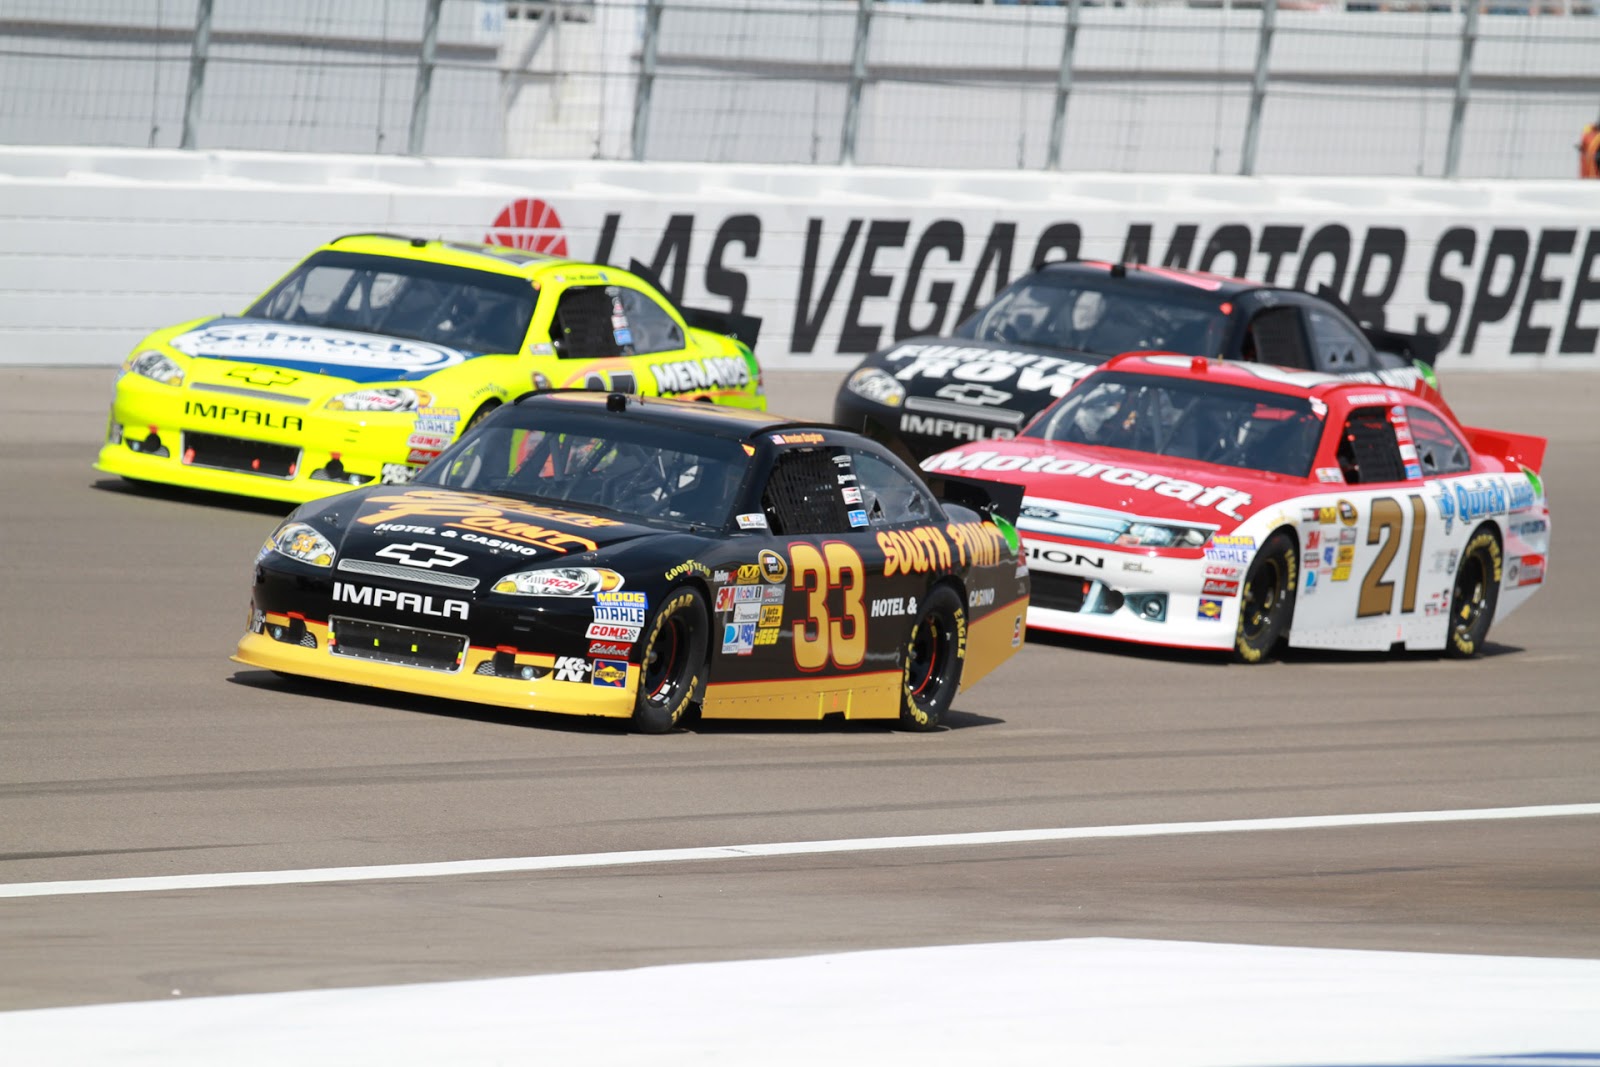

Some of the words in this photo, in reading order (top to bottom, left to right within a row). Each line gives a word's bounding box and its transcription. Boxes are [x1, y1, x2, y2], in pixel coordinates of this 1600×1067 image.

[650, 356, 751, 394] MENARDS
[184, 401, 304, 431] IMPALA
[415, 420, 455, 434] MAHLE
[410, 434, 441, 448] COMP
[930, 450, 1253, 516] Motorcraft
[374, 523, 436, 536] HOTEL
[440, 530, 458, 538] &
[461, 533, 537, 556] CASINO
[876, 526, 951, 577] SOUTH
[946, 520, 1004, 568] POINT
[1206, 549, 1248, 563] MAHLE
[1356, 494, 1427, 618] 21
[663, 559, 712, 582] GOODYEAR
[332, 581, 470, 621] IMPALA
[596, 592, 645, 603] MOOG
[716, 587, 737, 611] 3M
[737, 586, 755, 599] Mobil
[871, 600, 905, 618] HOTEL
[906, 596, 918, 615] &
[968, 587, 996, 608] CASINO
[594, 607, 643, 623] MAHLE
[787, 540, 867, 673] 33
[590, 625, 628, 637] COMP
[754, 628, 780, 646] JEGS
[953, 607, 966, 659] EAGLE
[588, 643, 631, 657] Edelbrock
[595, 668, 626, 679] SUNOCO
